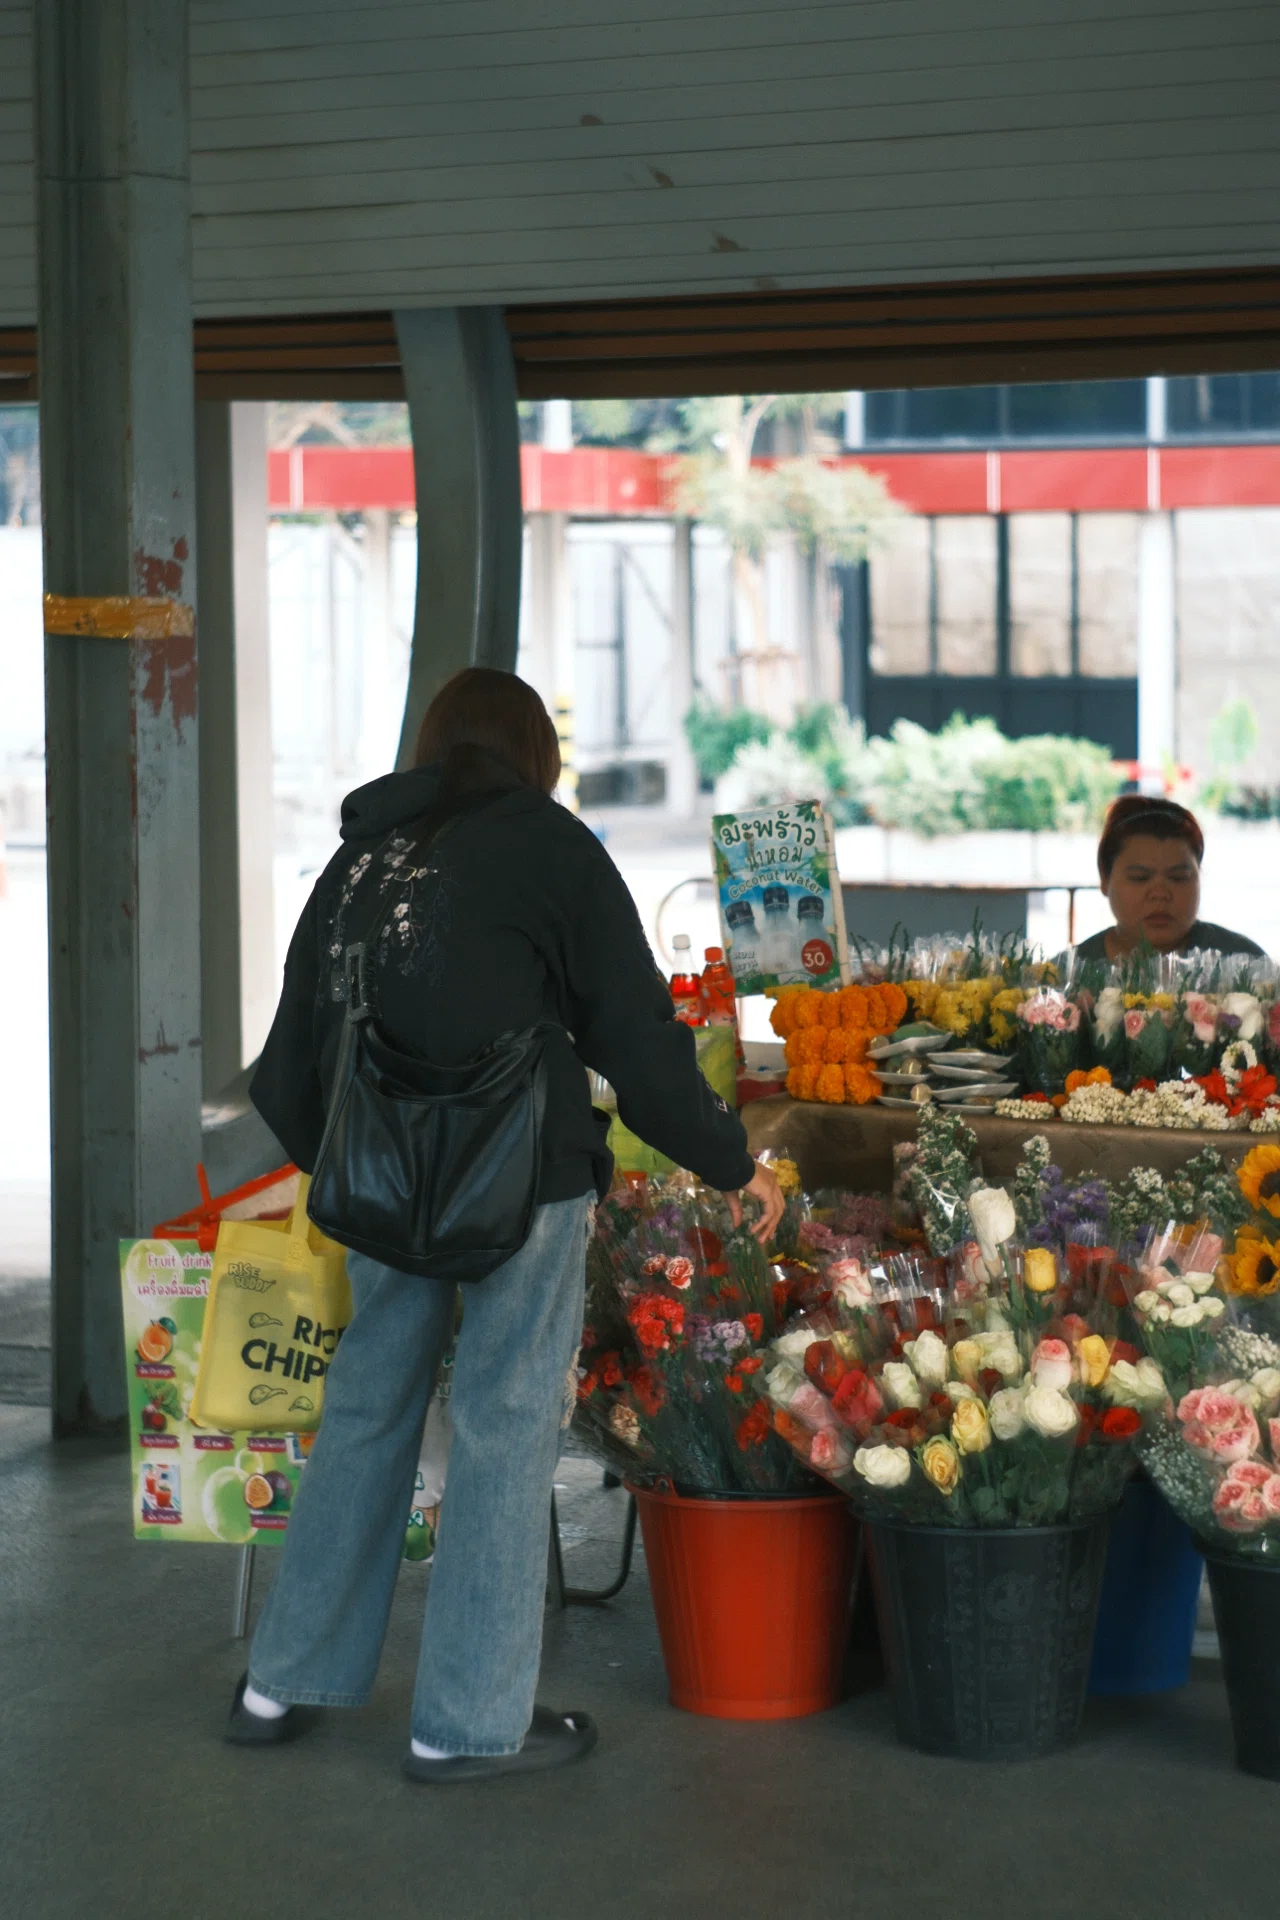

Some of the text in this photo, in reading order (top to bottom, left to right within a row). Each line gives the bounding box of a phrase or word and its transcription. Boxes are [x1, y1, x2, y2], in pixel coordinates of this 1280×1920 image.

[721, 810, 816, 846] มะพร้าว
[729, 869, 822, 899] Coconut Water
[803, 951, 826, 968] 30
[148, 1253, 212, 1268] Fruit drink
[228, 1261, 260, 1279] RISE
[137, 1274, 208, 1296] เครื่องดื่มผลไ
[241, 1338, 330, 1384] CHIP
